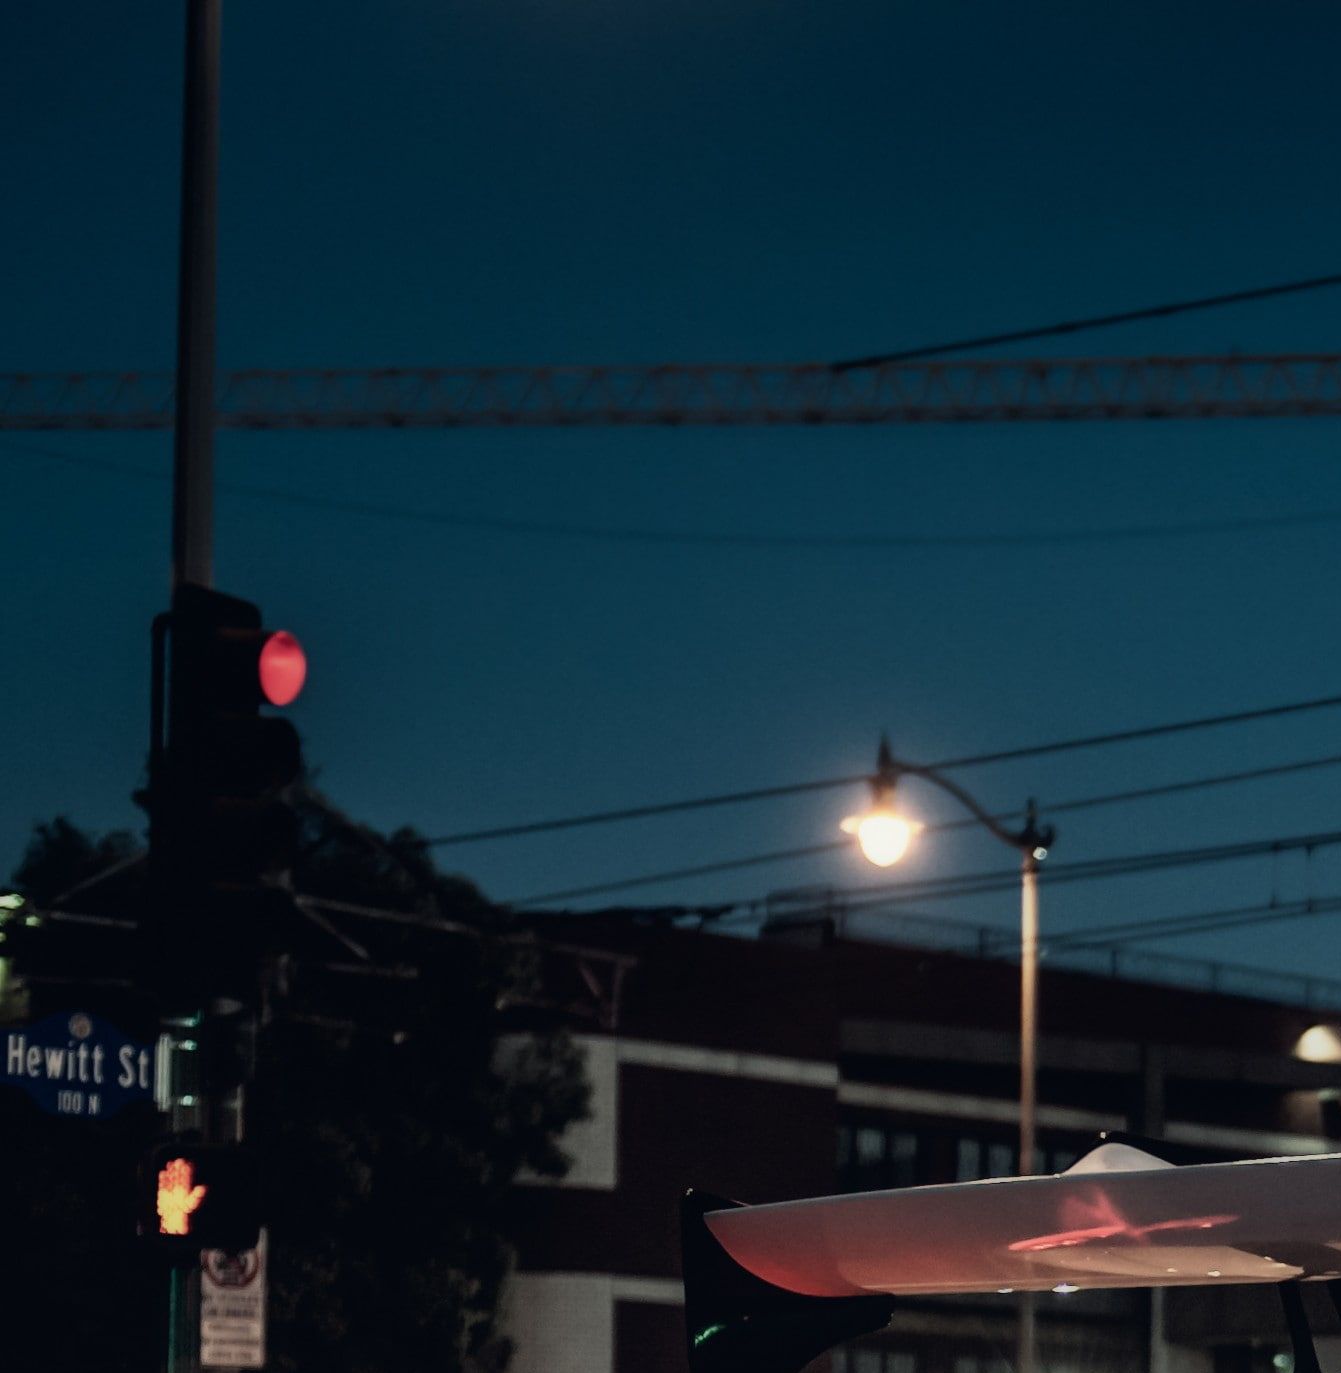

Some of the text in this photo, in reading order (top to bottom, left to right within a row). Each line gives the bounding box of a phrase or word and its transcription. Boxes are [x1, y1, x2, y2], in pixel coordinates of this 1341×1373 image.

[7, 1033, 149, 1089] Hewitt St
[57, 1089, 83, 1114] 100
